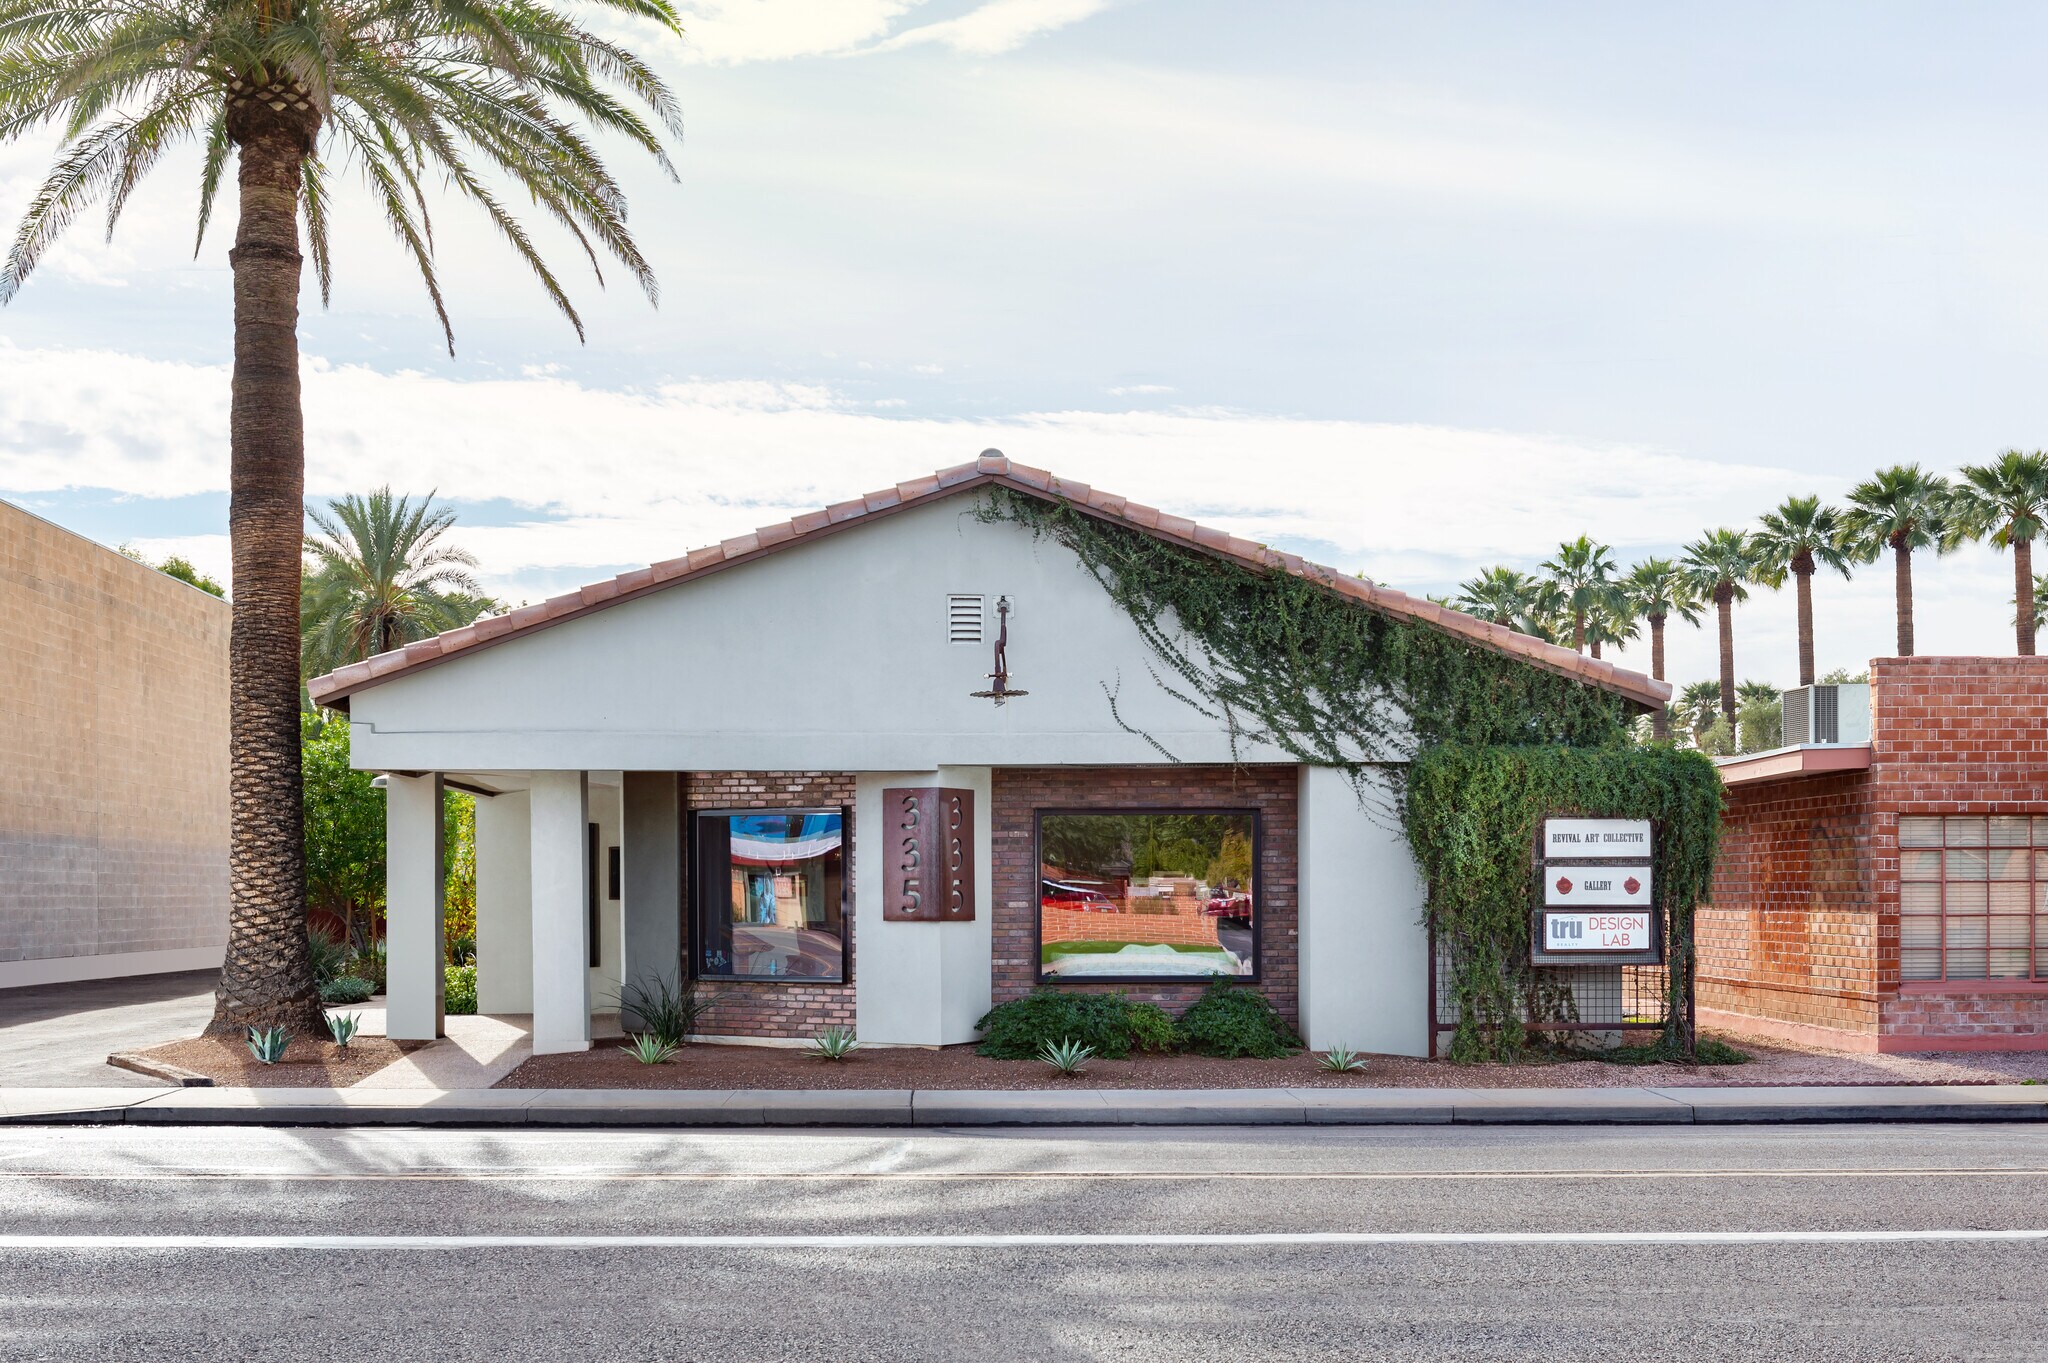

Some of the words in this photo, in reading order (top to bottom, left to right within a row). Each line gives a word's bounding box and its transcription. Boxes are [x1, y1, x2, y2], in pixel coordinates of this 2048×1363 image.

[1552, 833, 1581, 843] REVIVAL
[1585, 833, 1600, 843] ART
[1603, 833, 1644, 843] COLLECTIVE
[900, 795, 922, 913] 335
[951, 796, 964, 913] 335
[1584, 880, 1612, 891] GALLERY
[1589, 917, 1644, 930] DESIGN
[1602, 933, 1630, 947] LAB
